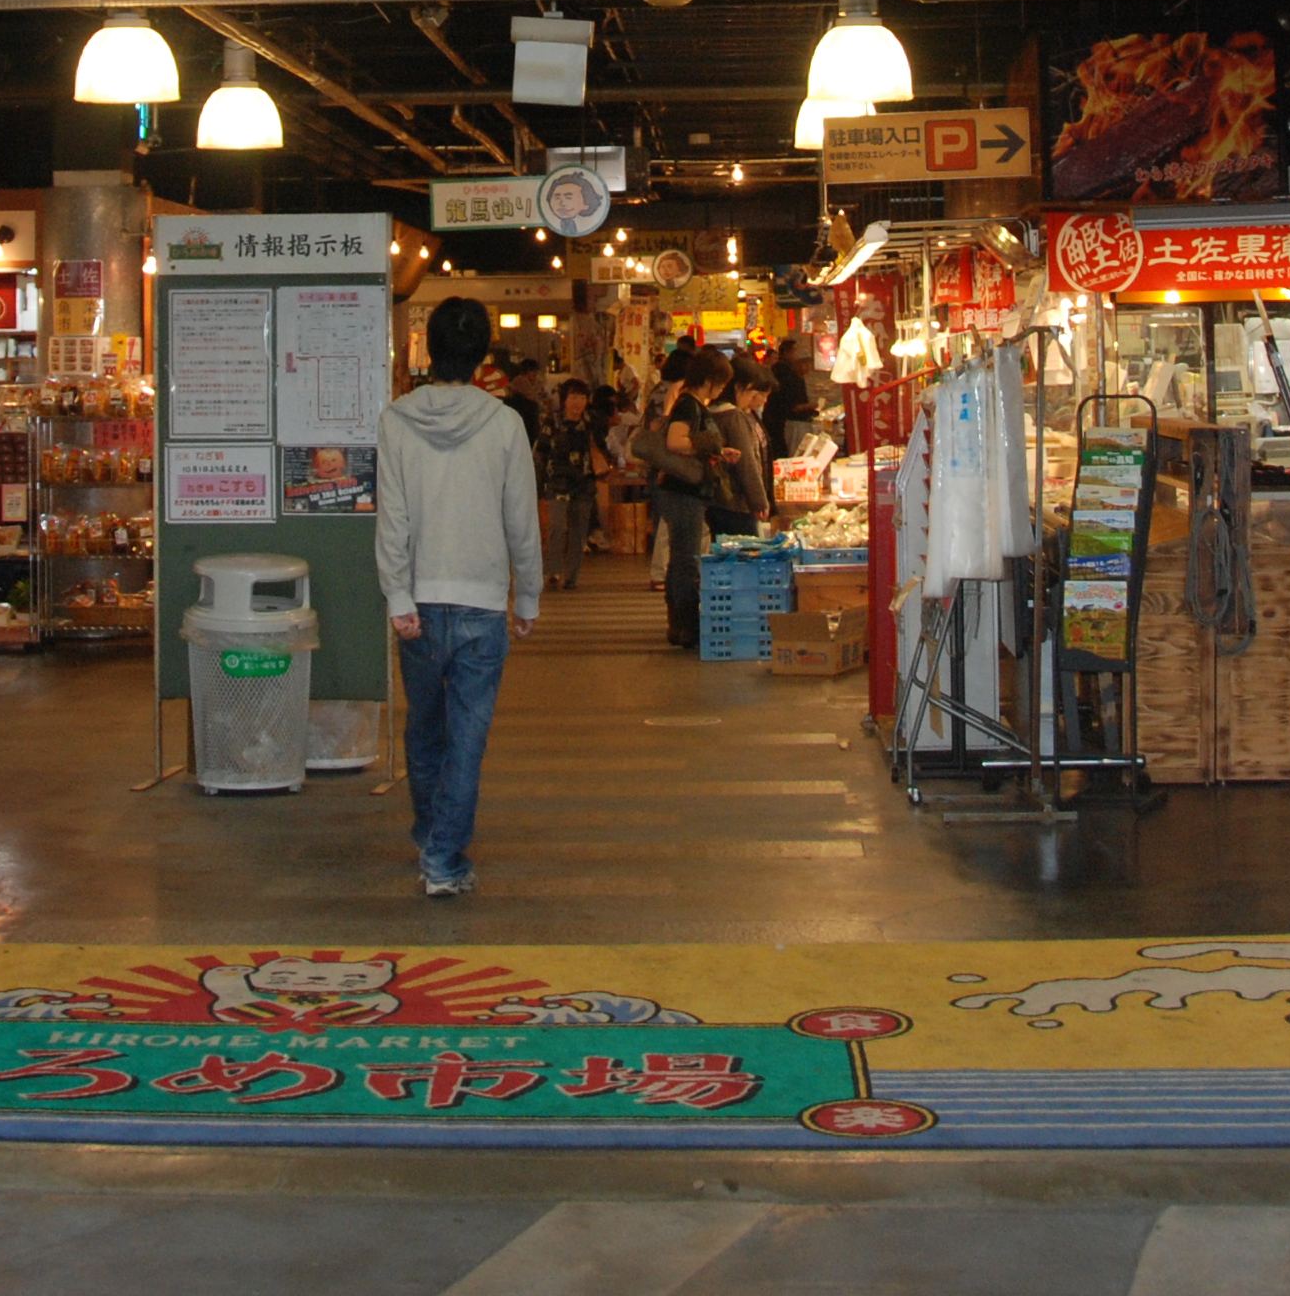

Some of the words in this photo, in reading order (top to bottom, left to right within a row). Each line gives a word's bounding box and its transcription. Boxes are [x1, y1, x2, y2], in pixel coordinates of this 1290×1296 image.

[828, 127, 921, 147] 駐車場入口
[933, 126, 969, 166] P
[445, 196, 533, 223] 龍馬通り
[234, 233, 365, 258] 情報掲示板
[1060, 218, 1120, 282] 鰹
[819, 1013, 885, 1034] 食
[831, 1106, 907, 1132] 楽
